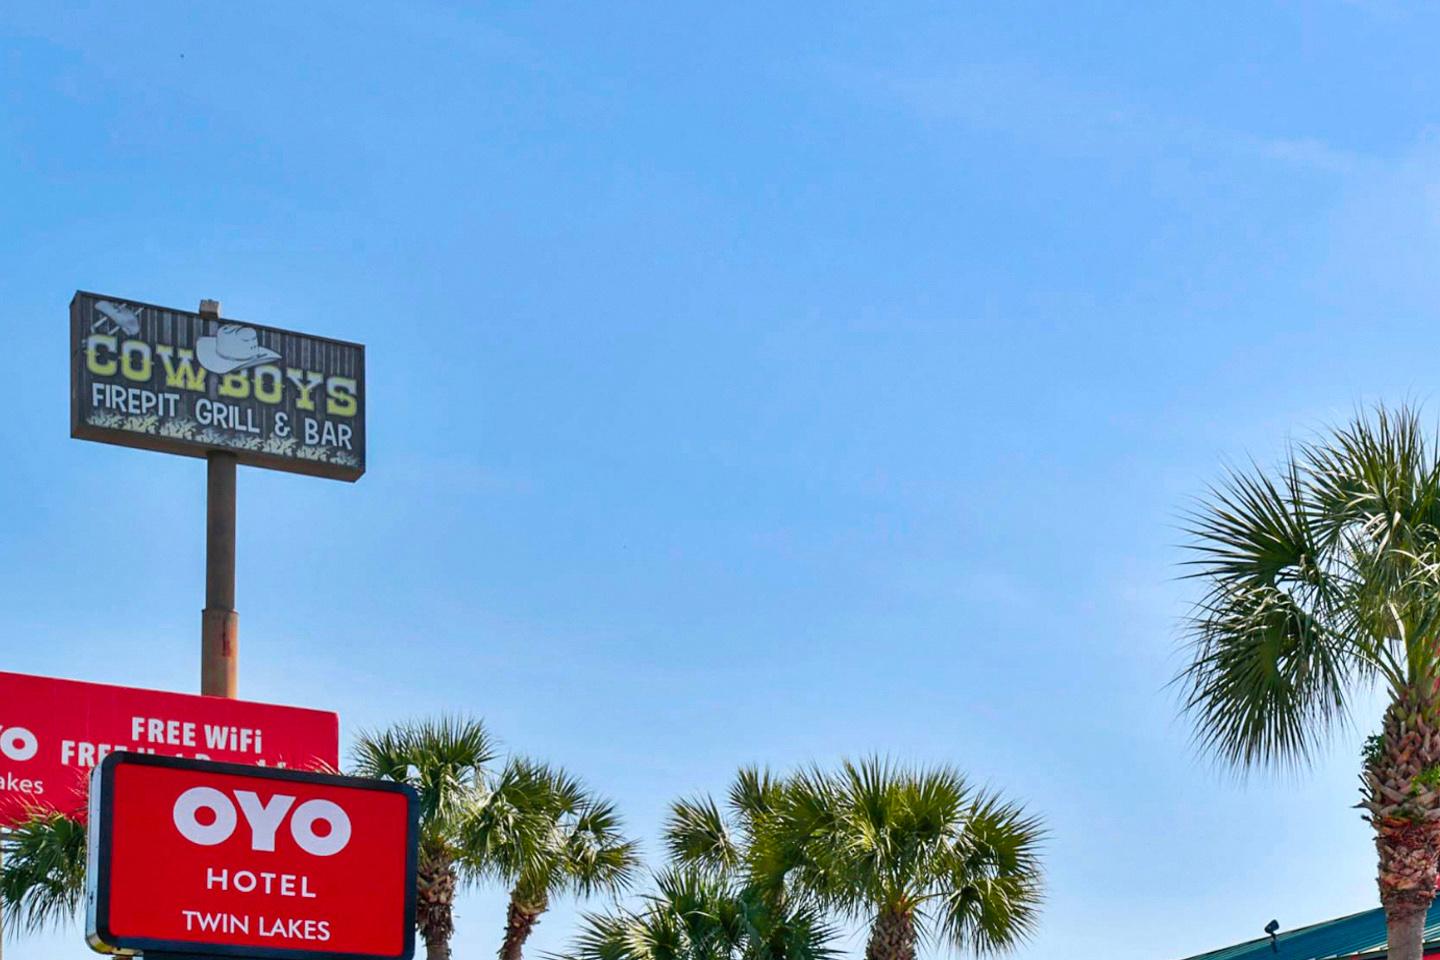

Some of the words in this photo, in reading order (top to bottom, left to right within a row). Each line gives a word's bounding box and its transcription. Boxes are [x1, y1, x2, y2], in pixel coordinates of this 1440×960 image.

[85, 333, 358, 418] COWBOYS
[91, 382, 180, 417] FIREPIT
[195, 398, 260, 434] GRILL
[273, 411, 291, 437] &
[304, 417, 353, 450] BAR
[60, 739, 129, 768] FRE
[131, 716, 197, 747] FREE
[204, 724, 262, 754] WiFi
[173, 786, 352, 857] OYO
[206, 867, 317, 899] HOTEL
[182, 909, 249, 935] TWIN
[258, 916, 331, 941] LAKES
